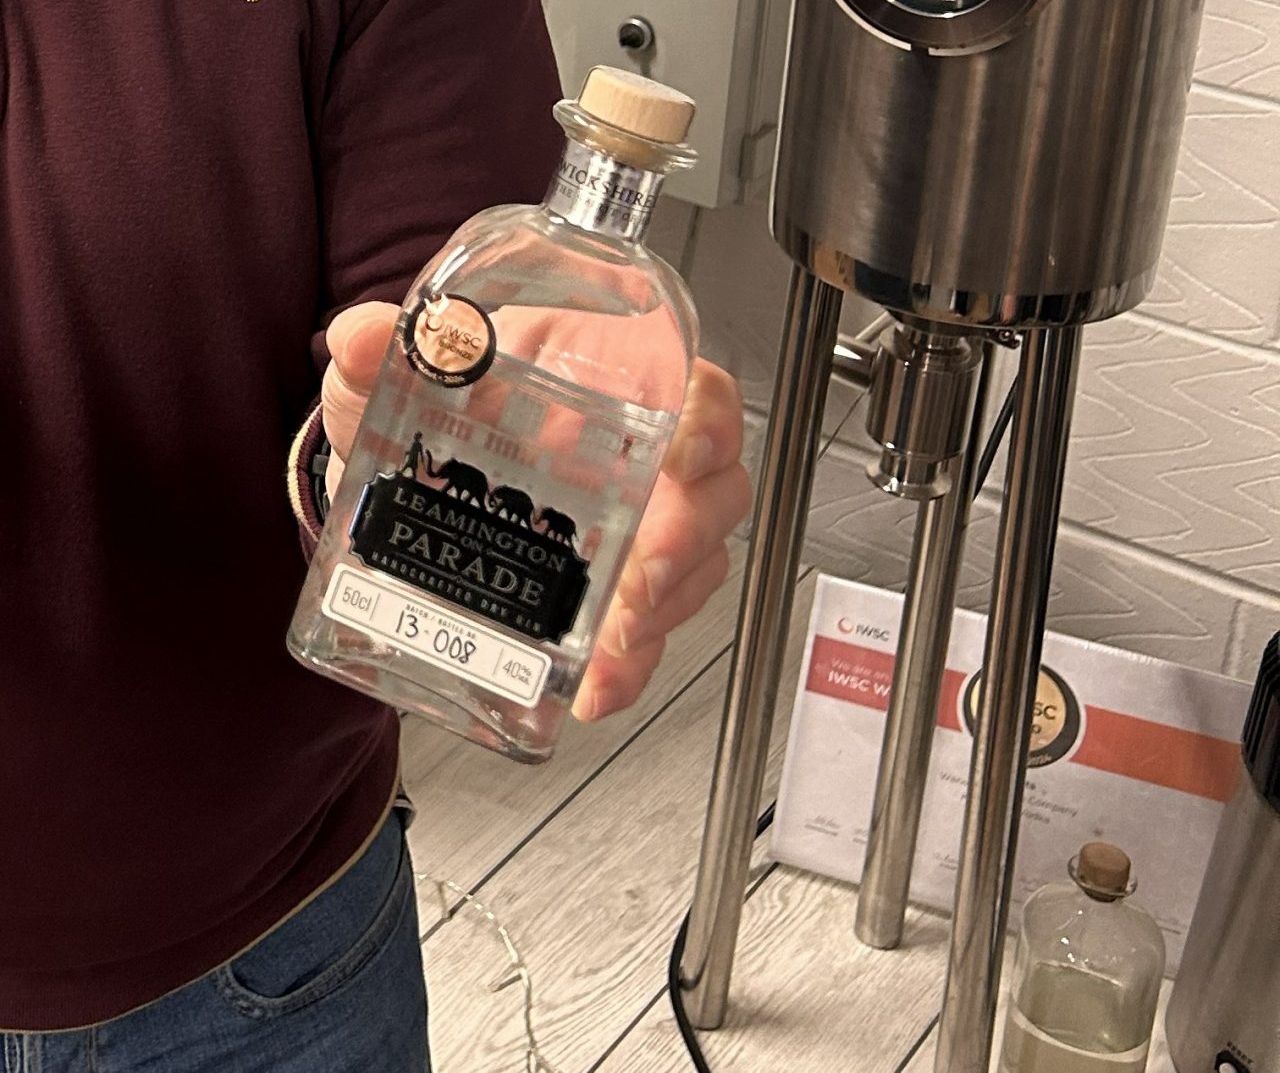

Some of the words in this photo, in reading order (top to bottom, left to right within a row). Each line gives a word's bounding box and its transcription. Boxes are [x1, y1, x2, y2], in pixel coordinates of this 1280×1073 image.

[443, 325, 482, 350] IWSC
[392, 486, 568, 574] LEAMINGTON
[460, 536, 485, 554] ON
[388, 521, 546, 608] PARADE
[341, 586, 372, 612] 50cl
[480, 598, 509, 618] DRY
[395, 610, 419, 639] 13
[433, 628, 477, 665] 008
[855, 624, 890, 642] IWSC
[828, 670, 871, 693] IWSC
